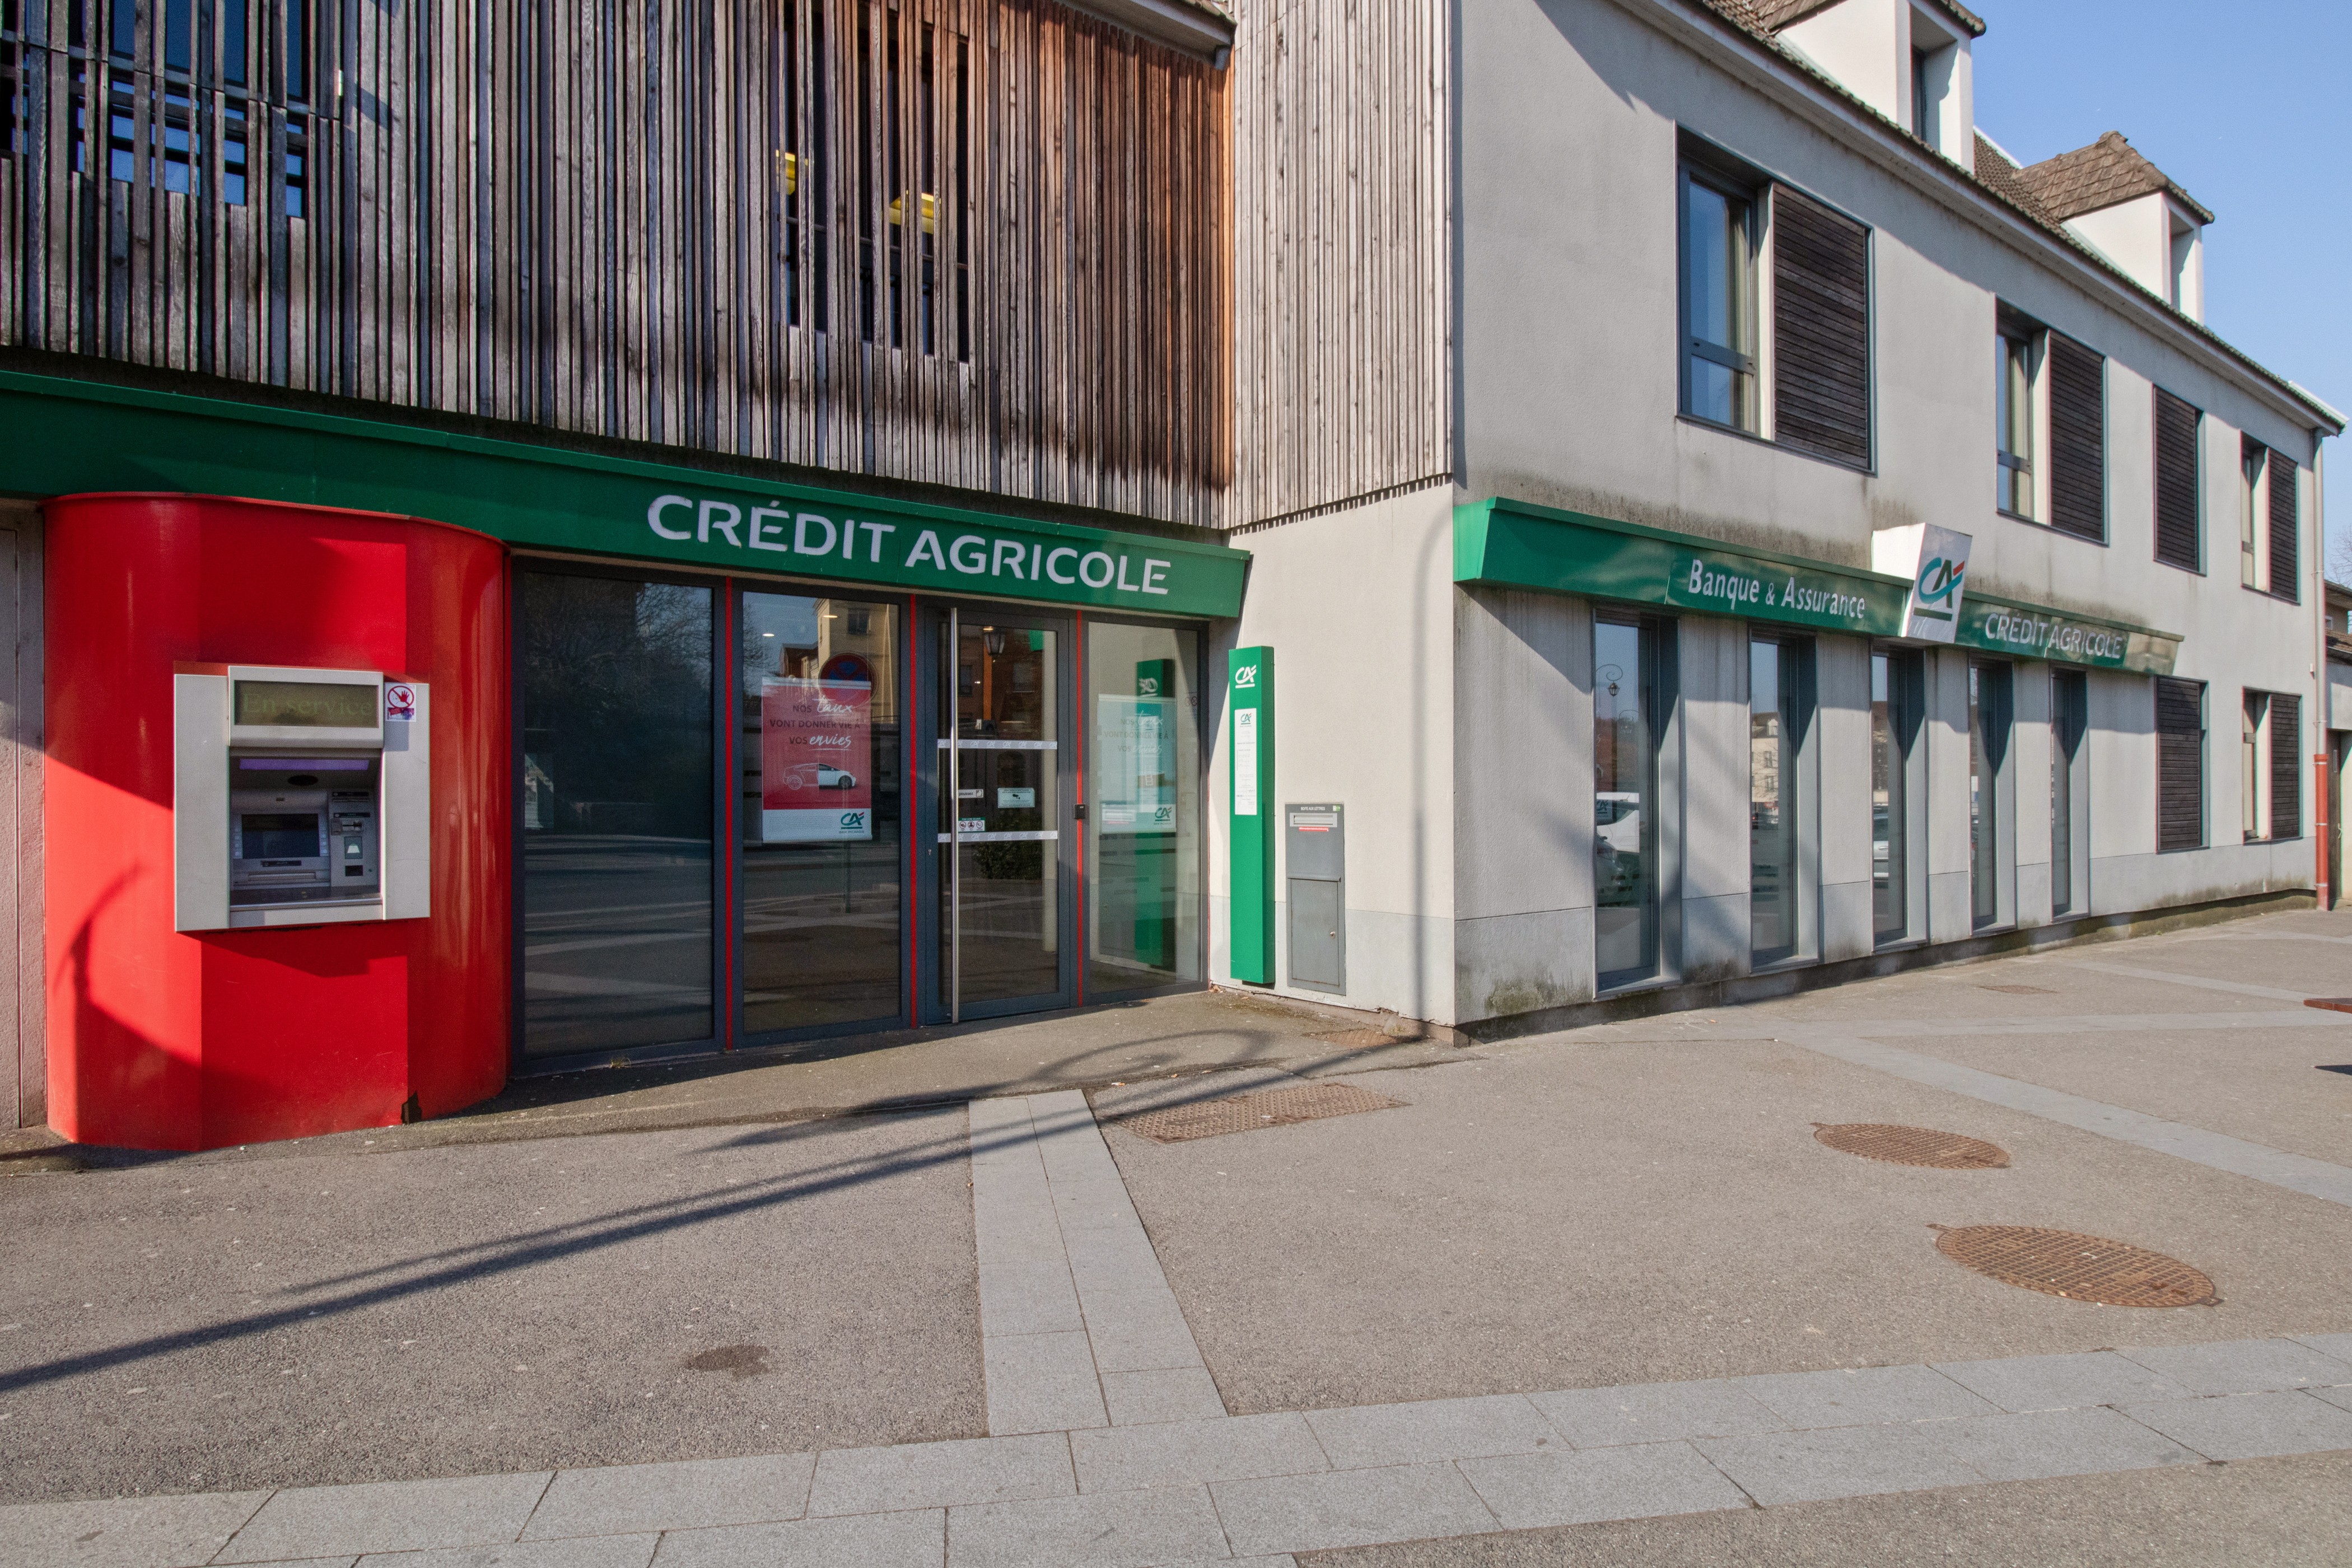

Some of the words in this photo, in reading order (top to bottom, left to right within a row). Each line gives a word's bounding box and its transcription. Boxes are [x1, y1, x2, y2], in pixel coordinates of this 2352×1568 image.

[647, 494, 896, 562] CRÉDIT
[904, 529, 1172, 595] AGRICOLE
[1687, 559, 1760, 610] Banque
[1766, 582, 1775, 605] &
[1781, 576, 1866, 619] Assurance
[2048, 626, 2124, 659] AGRICOLE
[244, 693, 276, 713] En
[284, 696, 372, 716] service
[793, 704, 813, 713] NOS
[812, 695, 853, 713] taux
[770, 719, 796, 728] VONT
[798, 720, 836, 729] DONNER
[789, 736, 807, 745] VOS
[810, 733, 852, 749] envies
[1104, 730, 1123, 739] VONT
